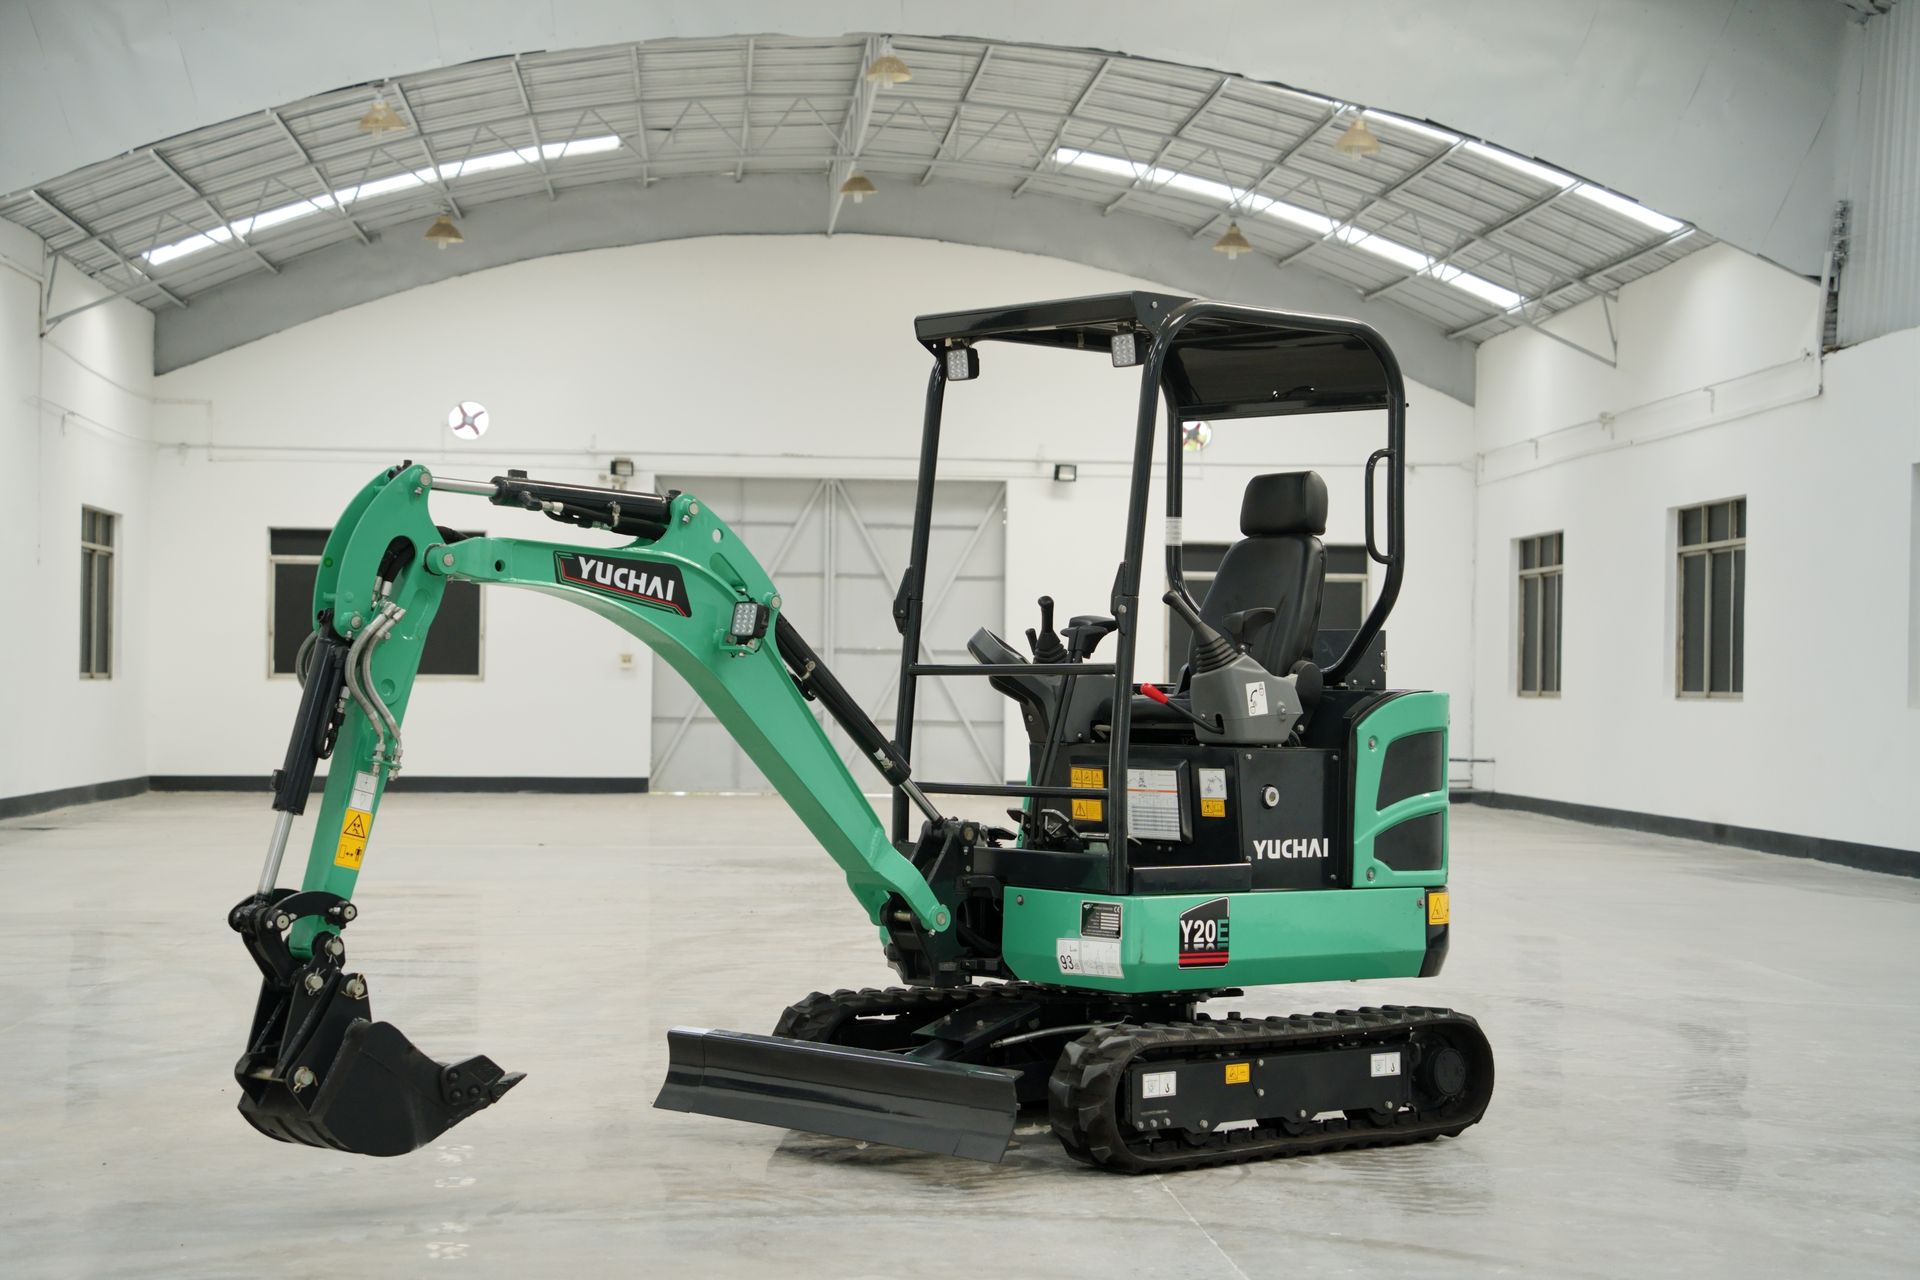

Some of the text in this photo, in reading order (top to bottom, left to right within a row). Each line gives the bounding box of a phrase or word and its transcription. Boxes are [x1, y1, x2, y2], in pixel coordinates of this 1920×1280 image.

[578, 556, 675, 601] YUCHAI
[1253, 838, 1329, 860] YUCHAI
[1180, 919, 1229, 943] Y20E
[1060, 954, 1074, 970] 93
